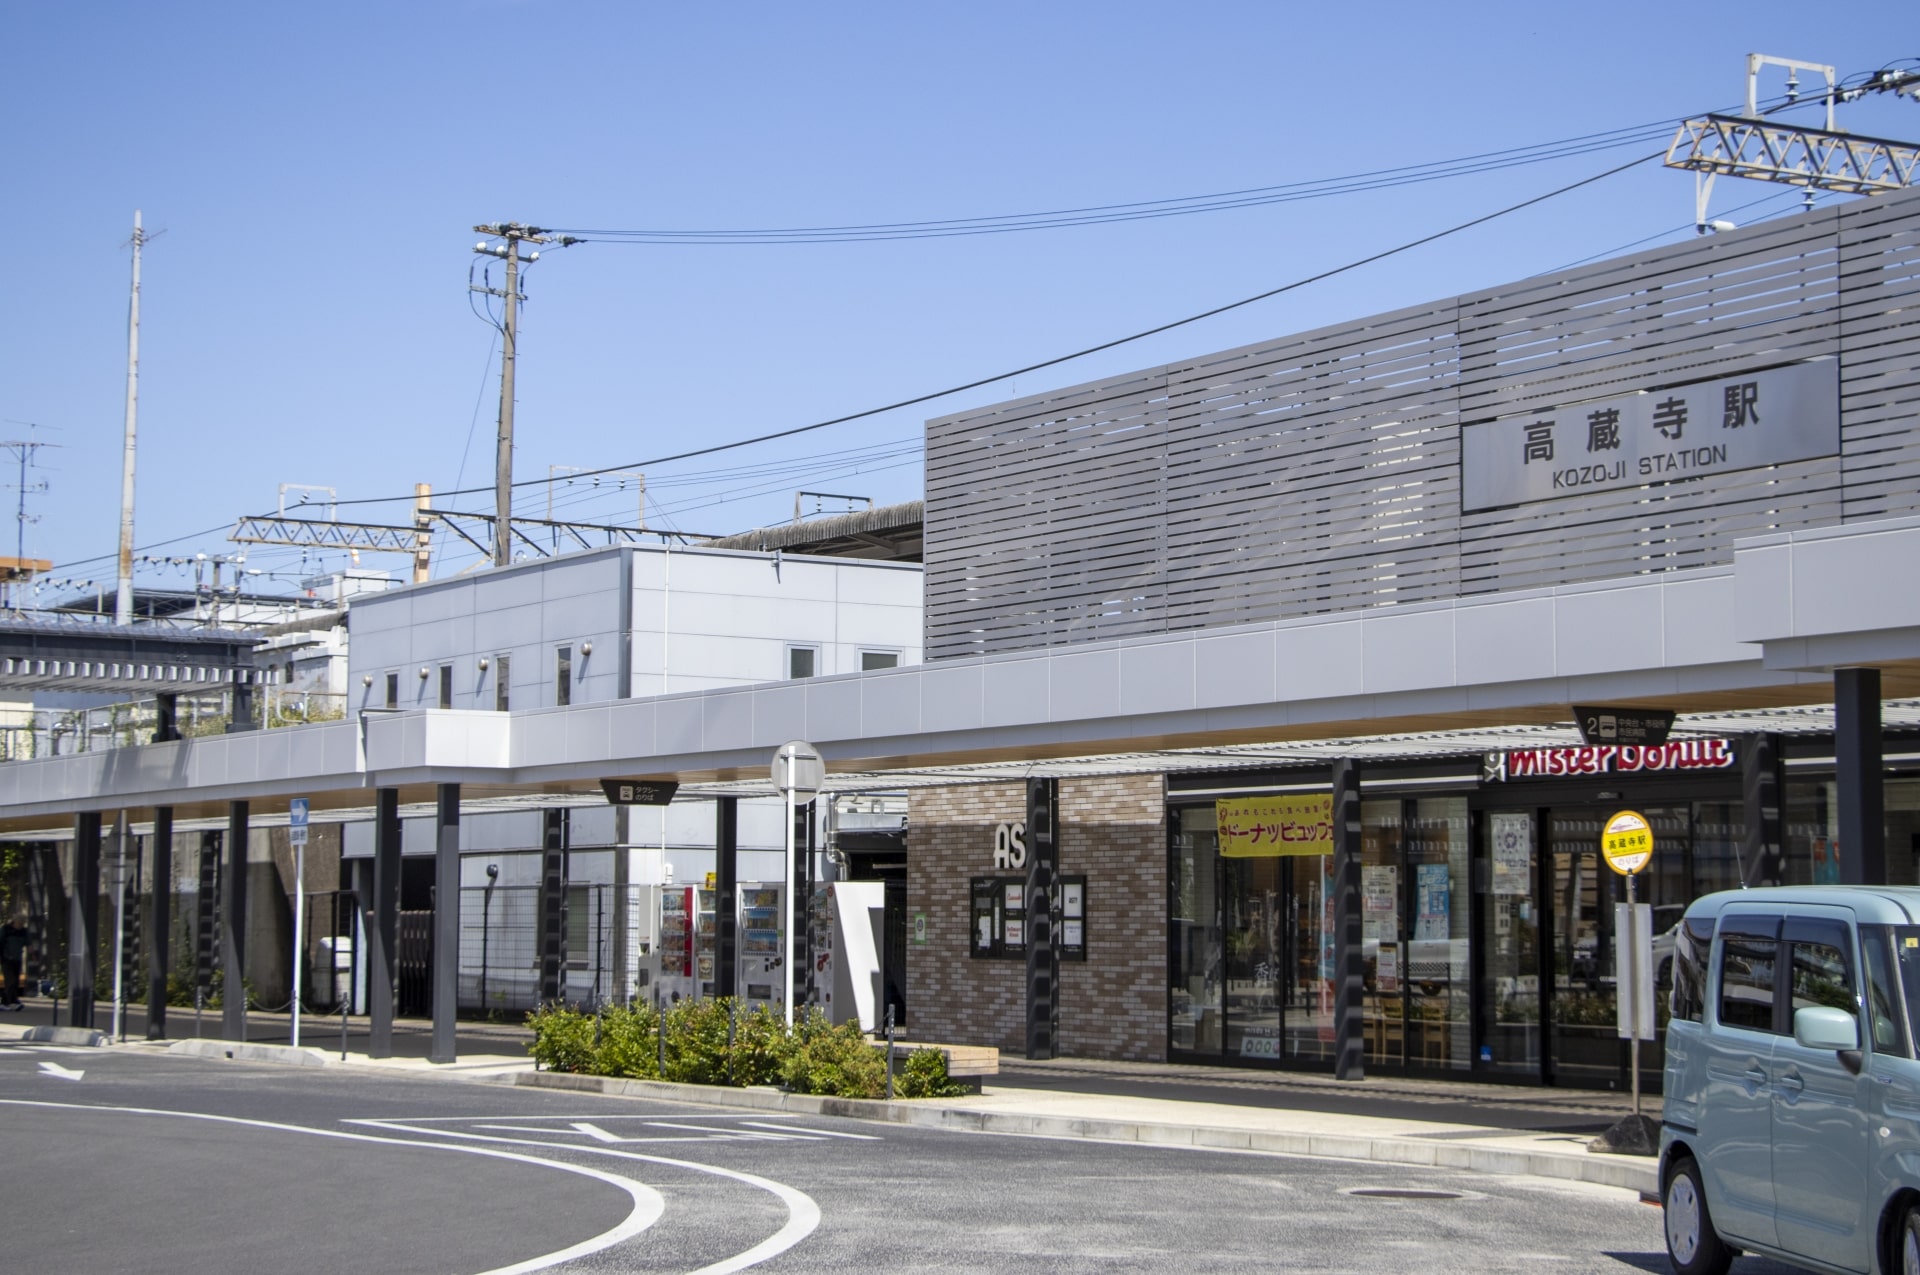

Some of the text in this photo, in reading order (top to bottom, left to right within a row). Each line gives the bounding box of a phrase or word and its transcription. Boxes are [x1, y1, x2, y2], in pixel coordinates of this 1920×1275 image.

[1522, 381, 1760, 465] 高蔵寺駅
[1552, 444, 1728, 489] KOZOJI STATION
[1587, 717, 1598, 735] 2
[993, 822, 1026, 869] AS
[1608, 834, 1646, 850] 高蔵寺駅
